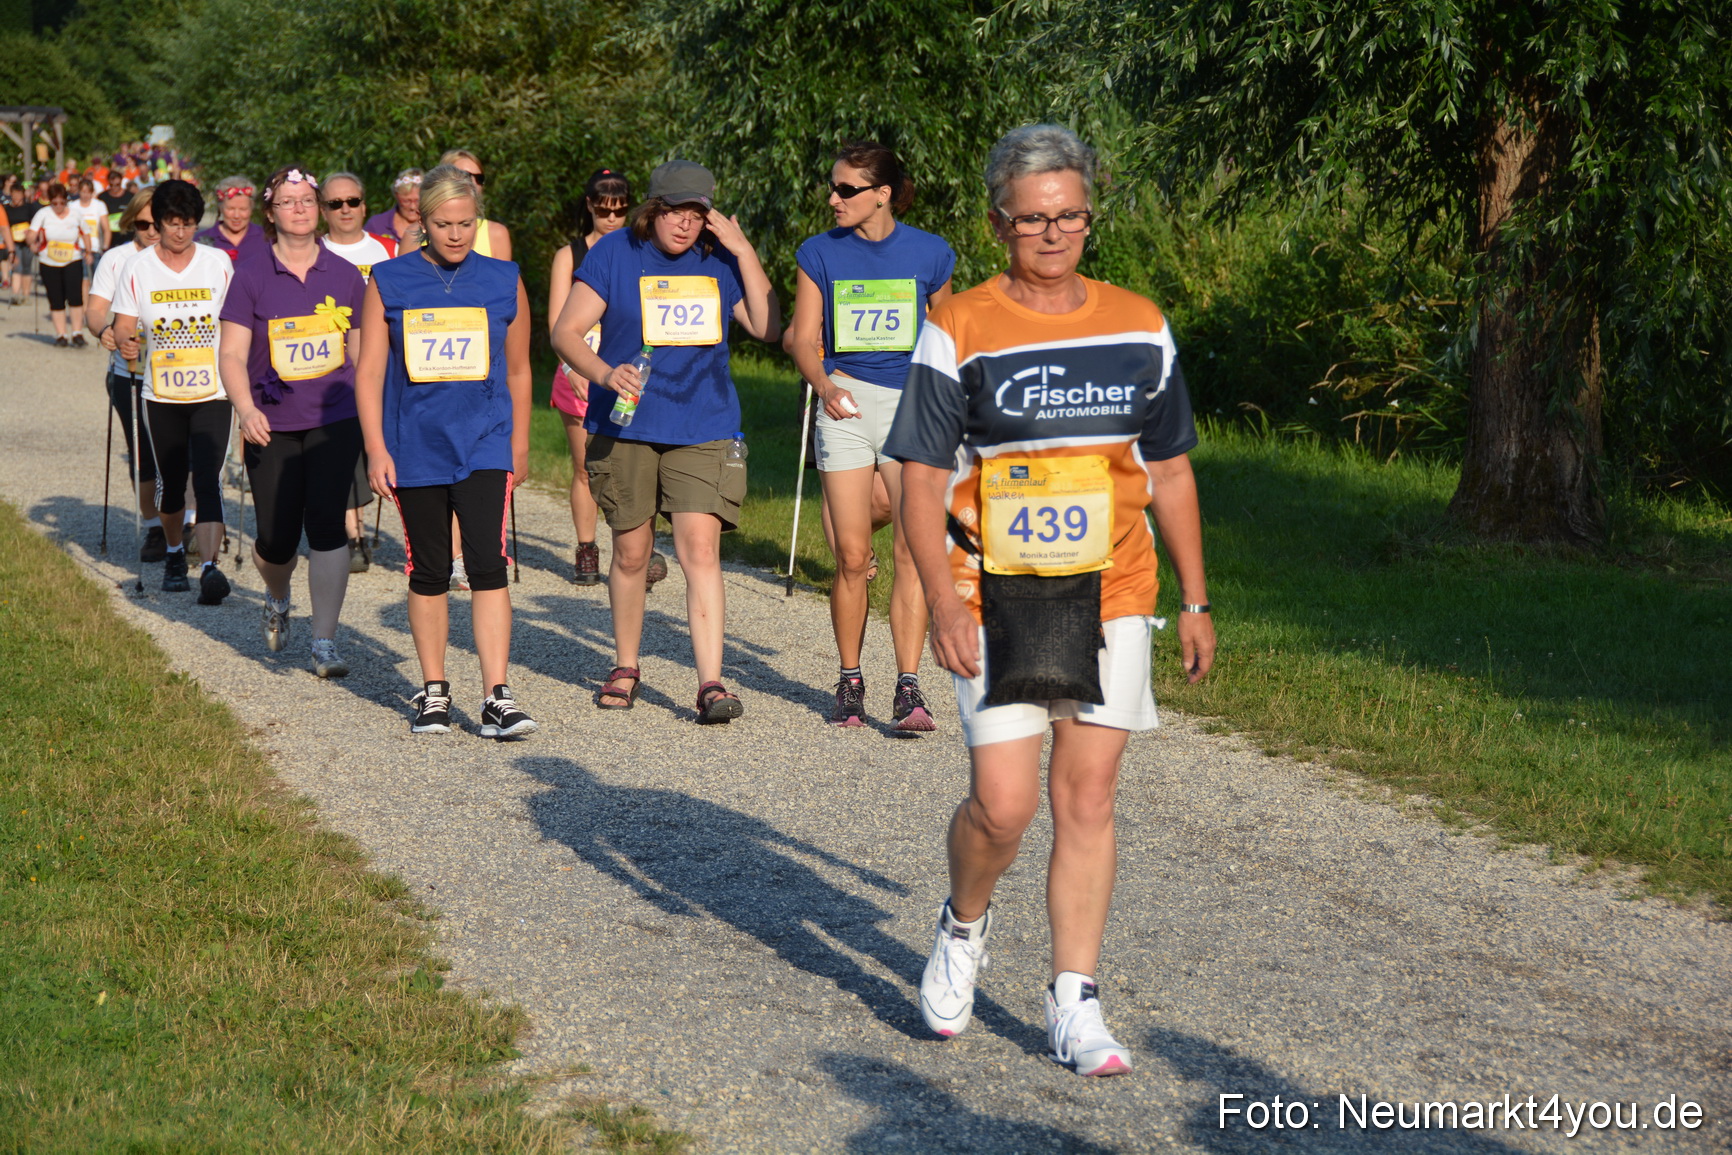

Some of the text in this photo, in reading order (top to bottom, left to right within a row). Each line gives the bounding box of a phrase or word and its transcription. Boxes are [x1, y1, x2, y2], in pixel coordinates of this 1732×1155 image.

[154, 290, 207, 302] ONLINE
[657, 304, 705, 327] 792
[851, 309, 900, 332] 775
[285, 339, 330, 363] 704
[422, 337, 471, 361] 747
[160, 369, 211, 388] 1023
[1023, 382, 1136, 409] Fischer
[1035, 404, 1132, 420] AUTOMOBILE
[1001, 477, 1047, 487] firmenlauf
[988, 490, 1025, 500] walken
[1008, 505, 1088, 543] 439
[1049, 551, 1079, 559] Gärtner
